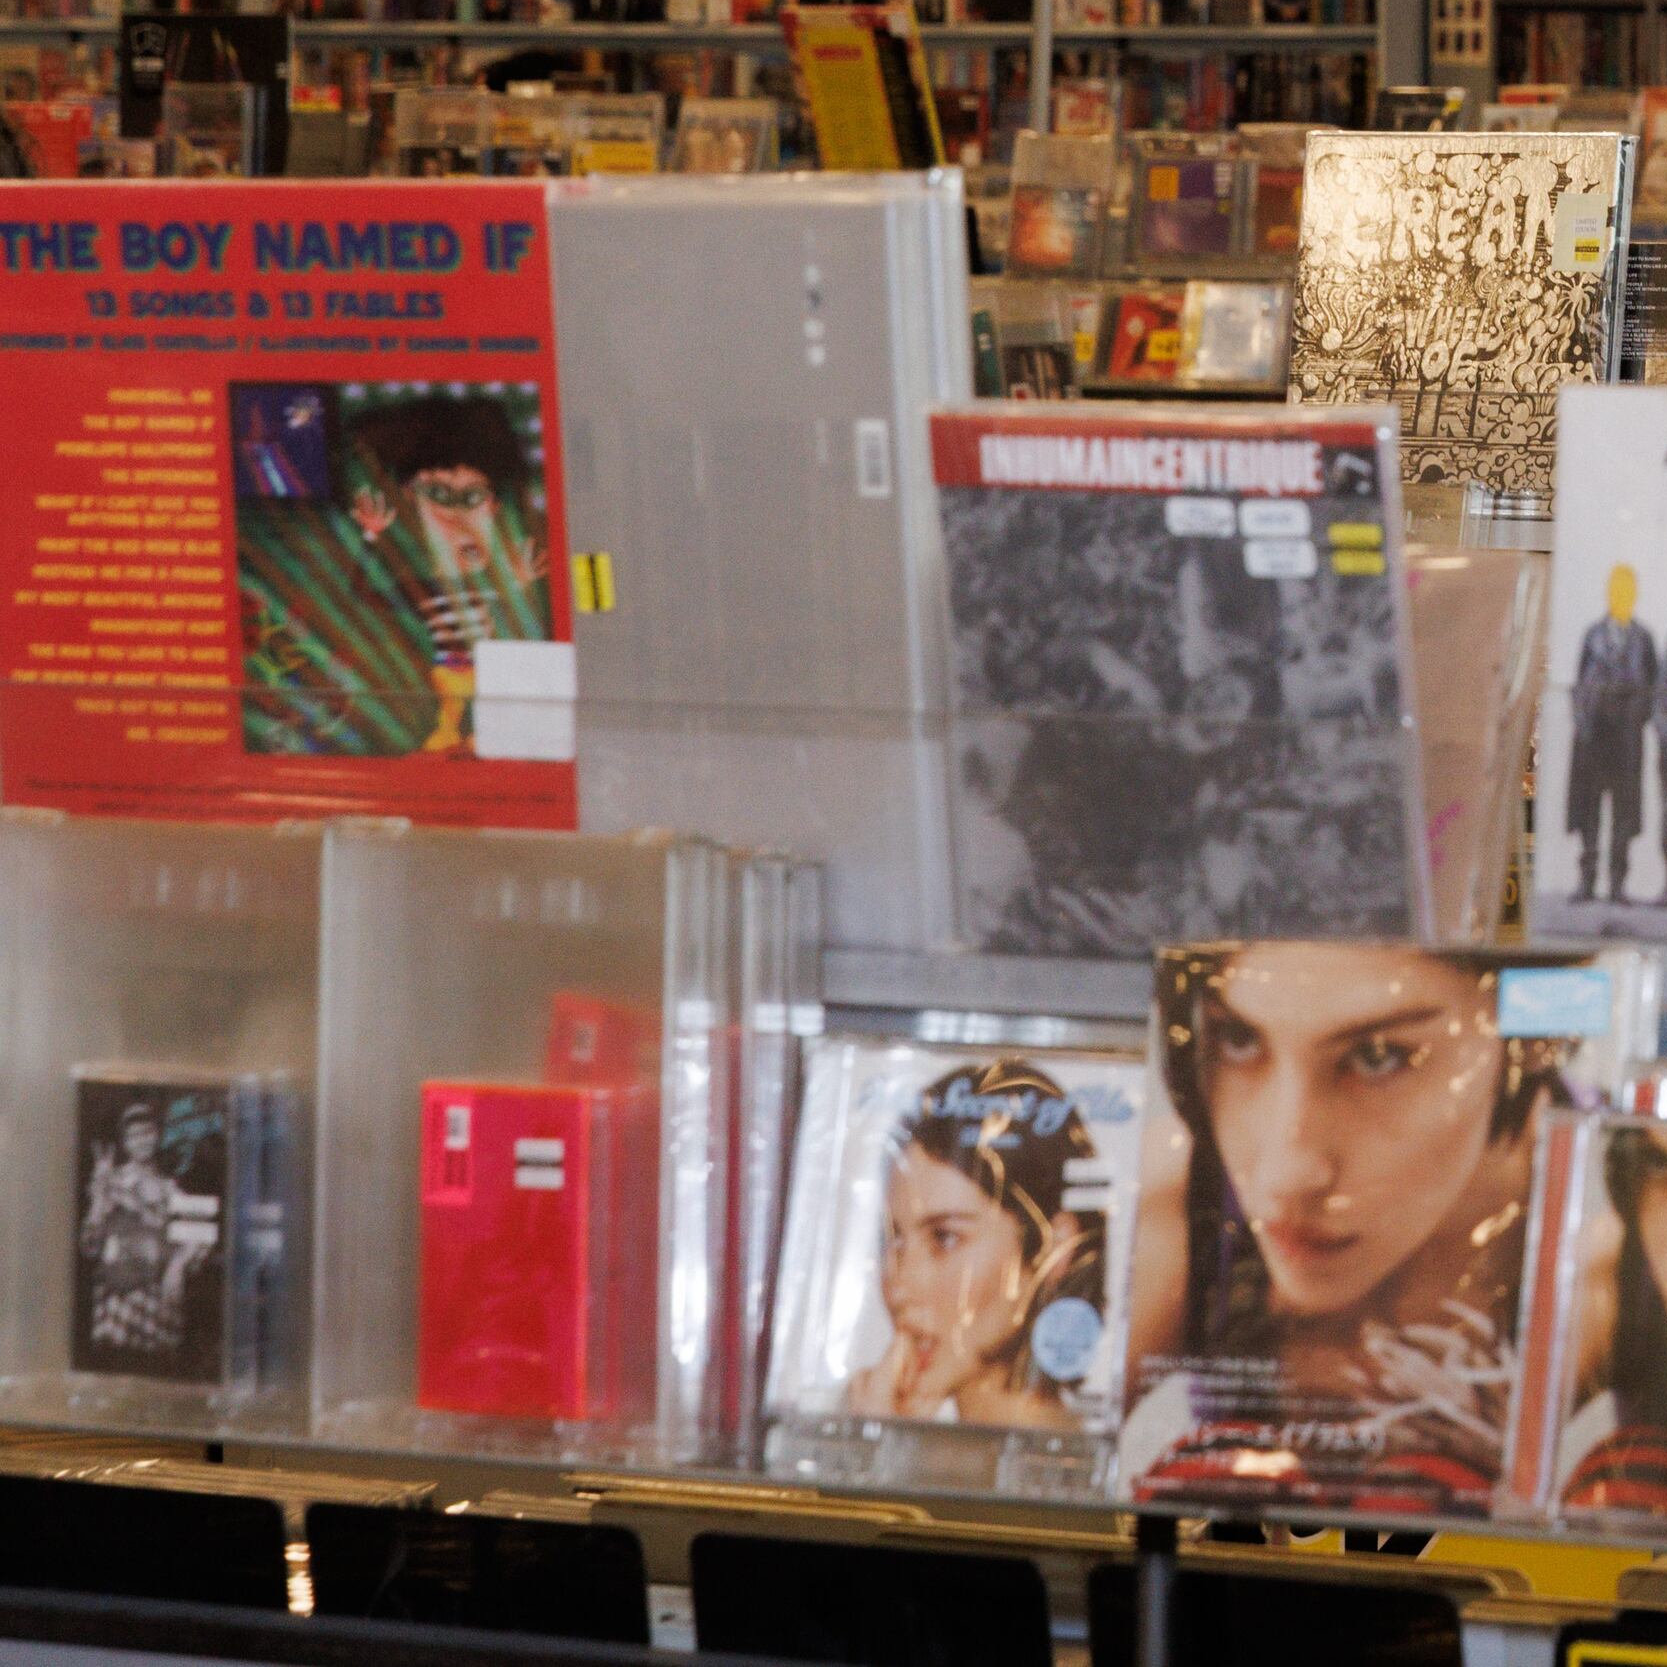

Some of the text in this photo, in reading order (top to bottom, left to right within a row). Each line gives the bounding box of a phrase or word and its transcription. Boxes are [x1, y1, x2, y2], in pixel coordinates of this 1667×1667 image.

[3, 220, 535, 274] THE BOY NAMED IF
[88, 290, 445, 320] 13 SONGS & 13 FABLES
